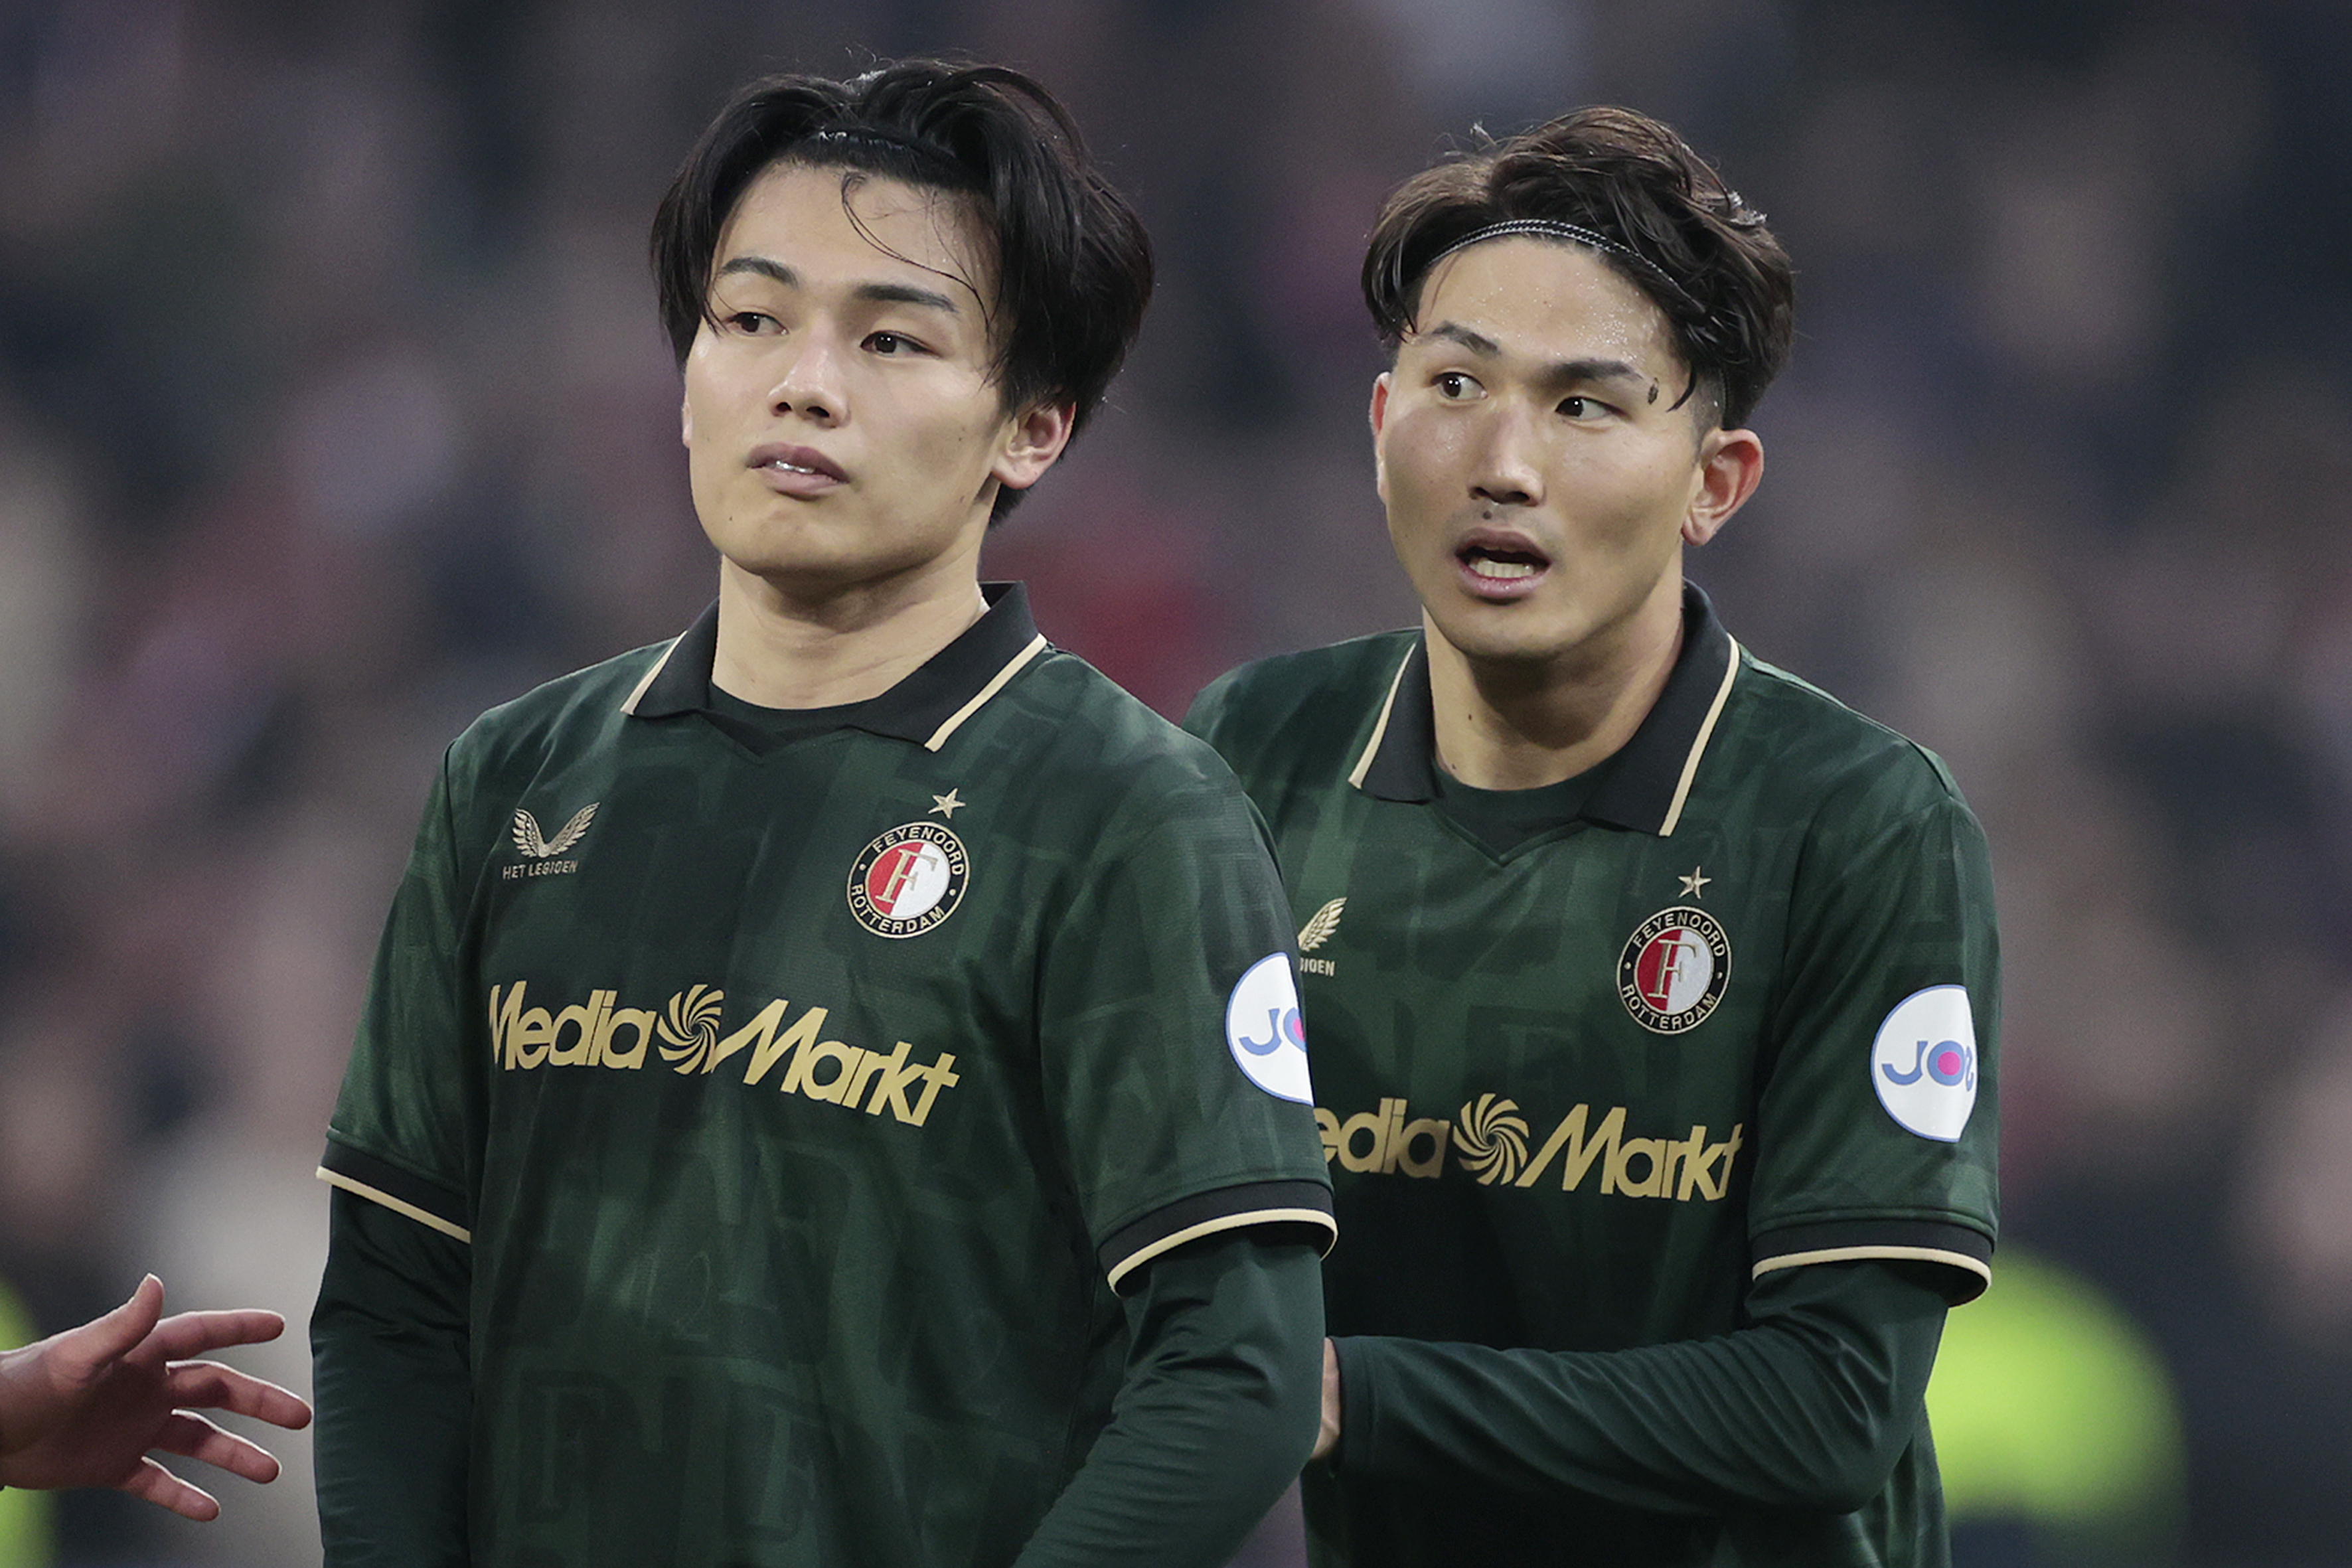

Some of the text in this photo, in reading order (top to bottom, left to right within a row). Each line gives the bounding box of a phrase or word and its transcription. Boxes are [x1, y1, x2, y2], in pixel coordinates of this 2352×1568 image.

[503, 860, 578, 880] HET LEGIOEN
[872, 826, 965, 876] FEYENOORD
[875, 848, 938, 904] F
[851, 884, 945, 933] ROTTERDAM
[1632, 912, 1726, 957] FEYENOORD
[1647, 939, 1699, 998] F
[1622, 984, 1717, 1030] ROTTERDAM
[489, 980, 961, 1127] Media Markt
[1313, 1098, 1743, 1202] edia Markt
